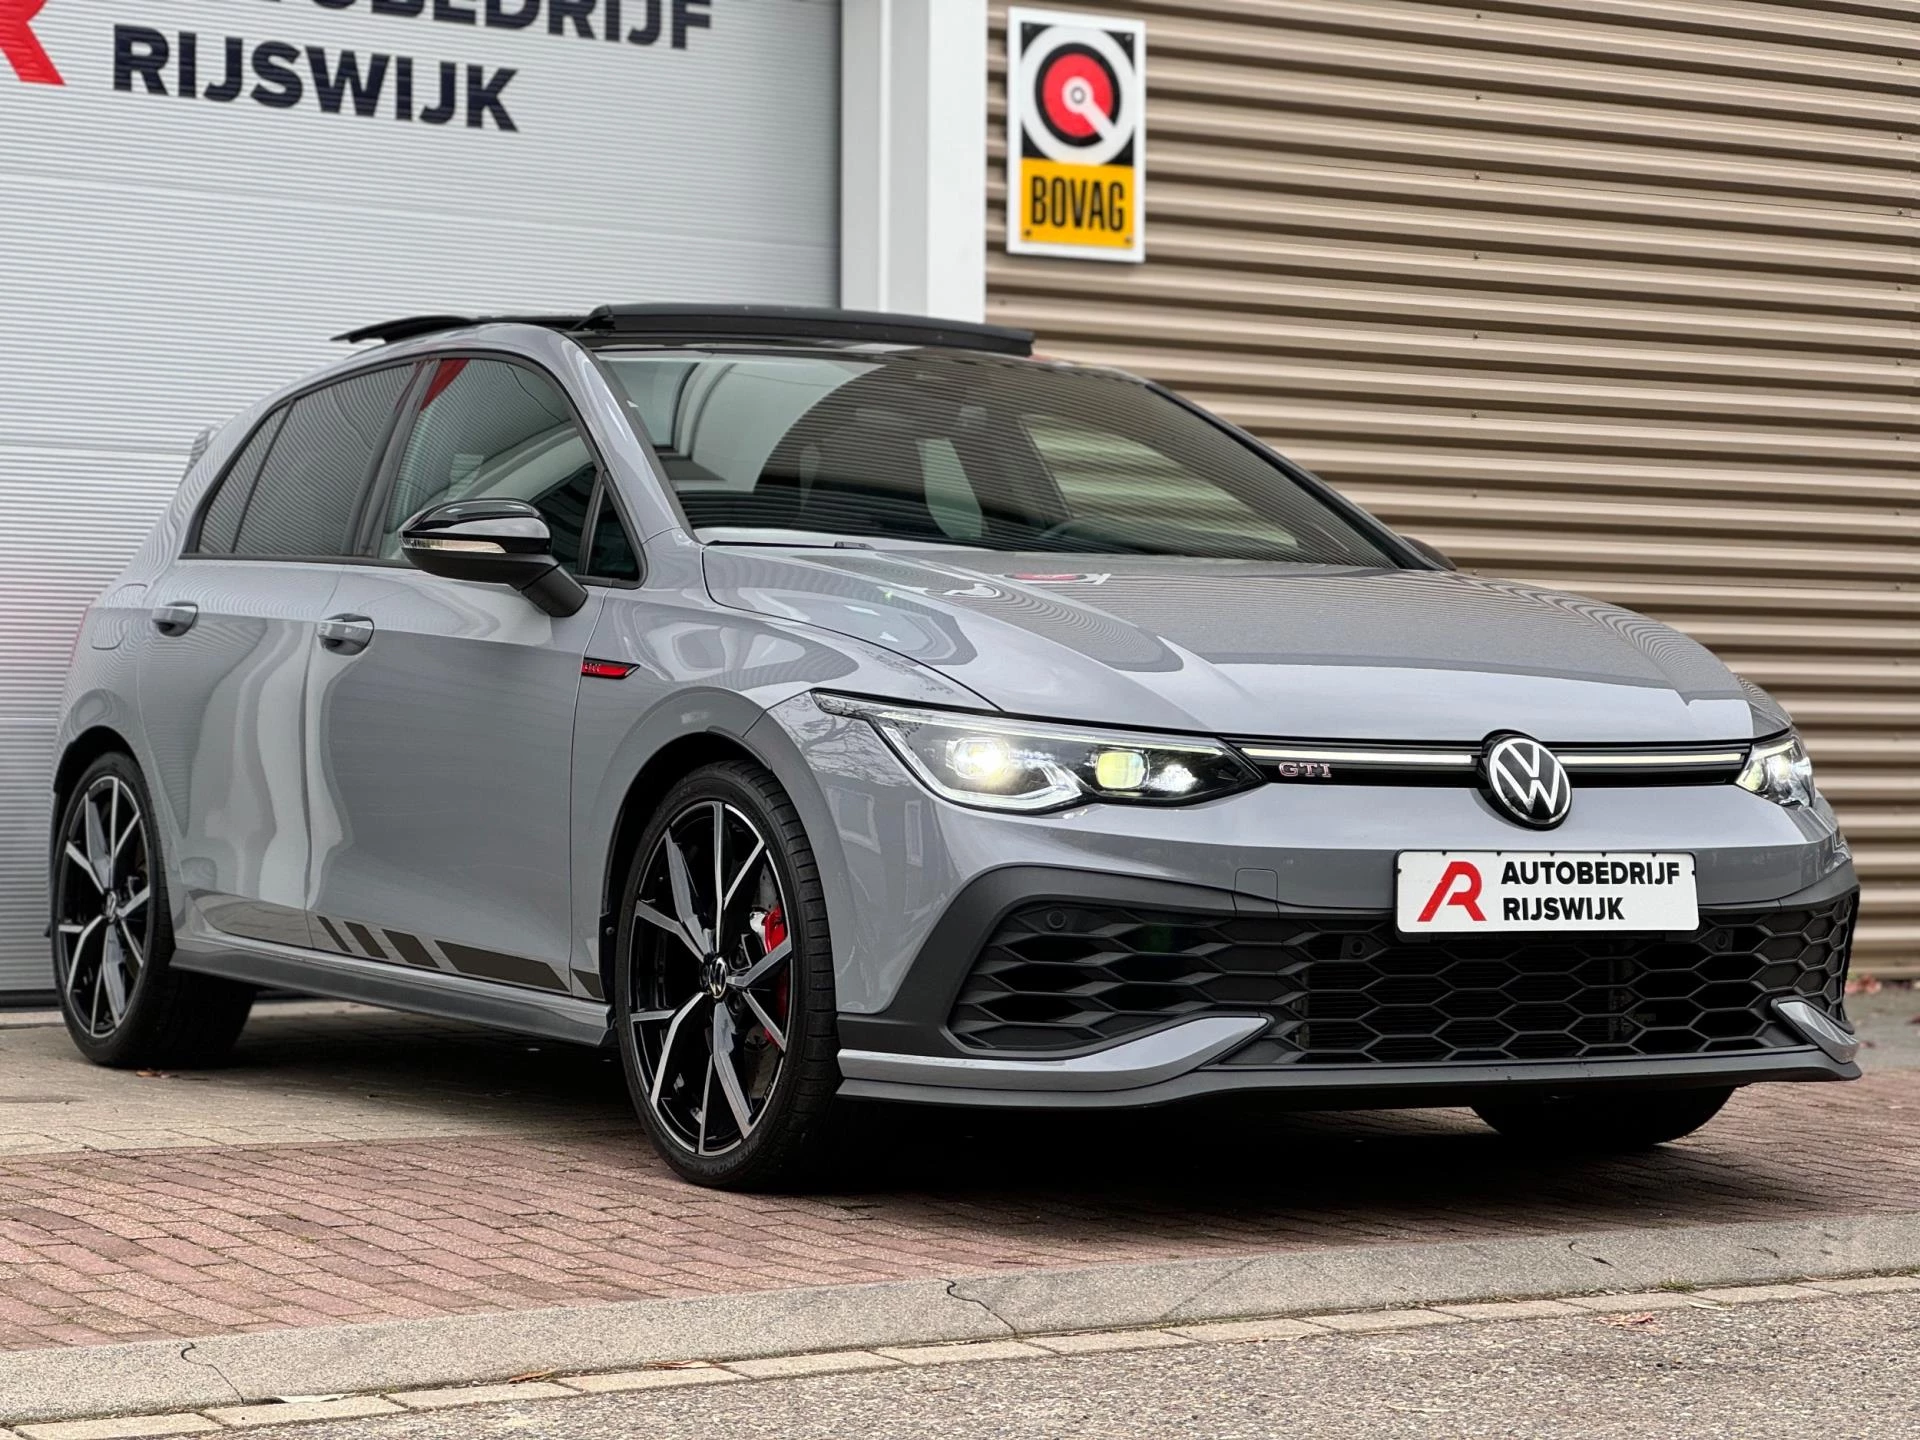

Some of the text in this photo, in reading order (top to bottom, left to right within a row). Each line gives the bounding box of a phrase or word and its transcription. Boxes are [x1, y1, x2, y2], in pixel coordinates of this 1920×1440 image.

[112, 23, 519, 132] RIJSWIJK
[1031, 175, 1124, 232] BOVAG
[1278, 761, 1333, 778] GTI
[1501, 861, 1680, 886] AUTOBEDRIJF
[1503, 897, 1625, 921] RIJSWIJK
